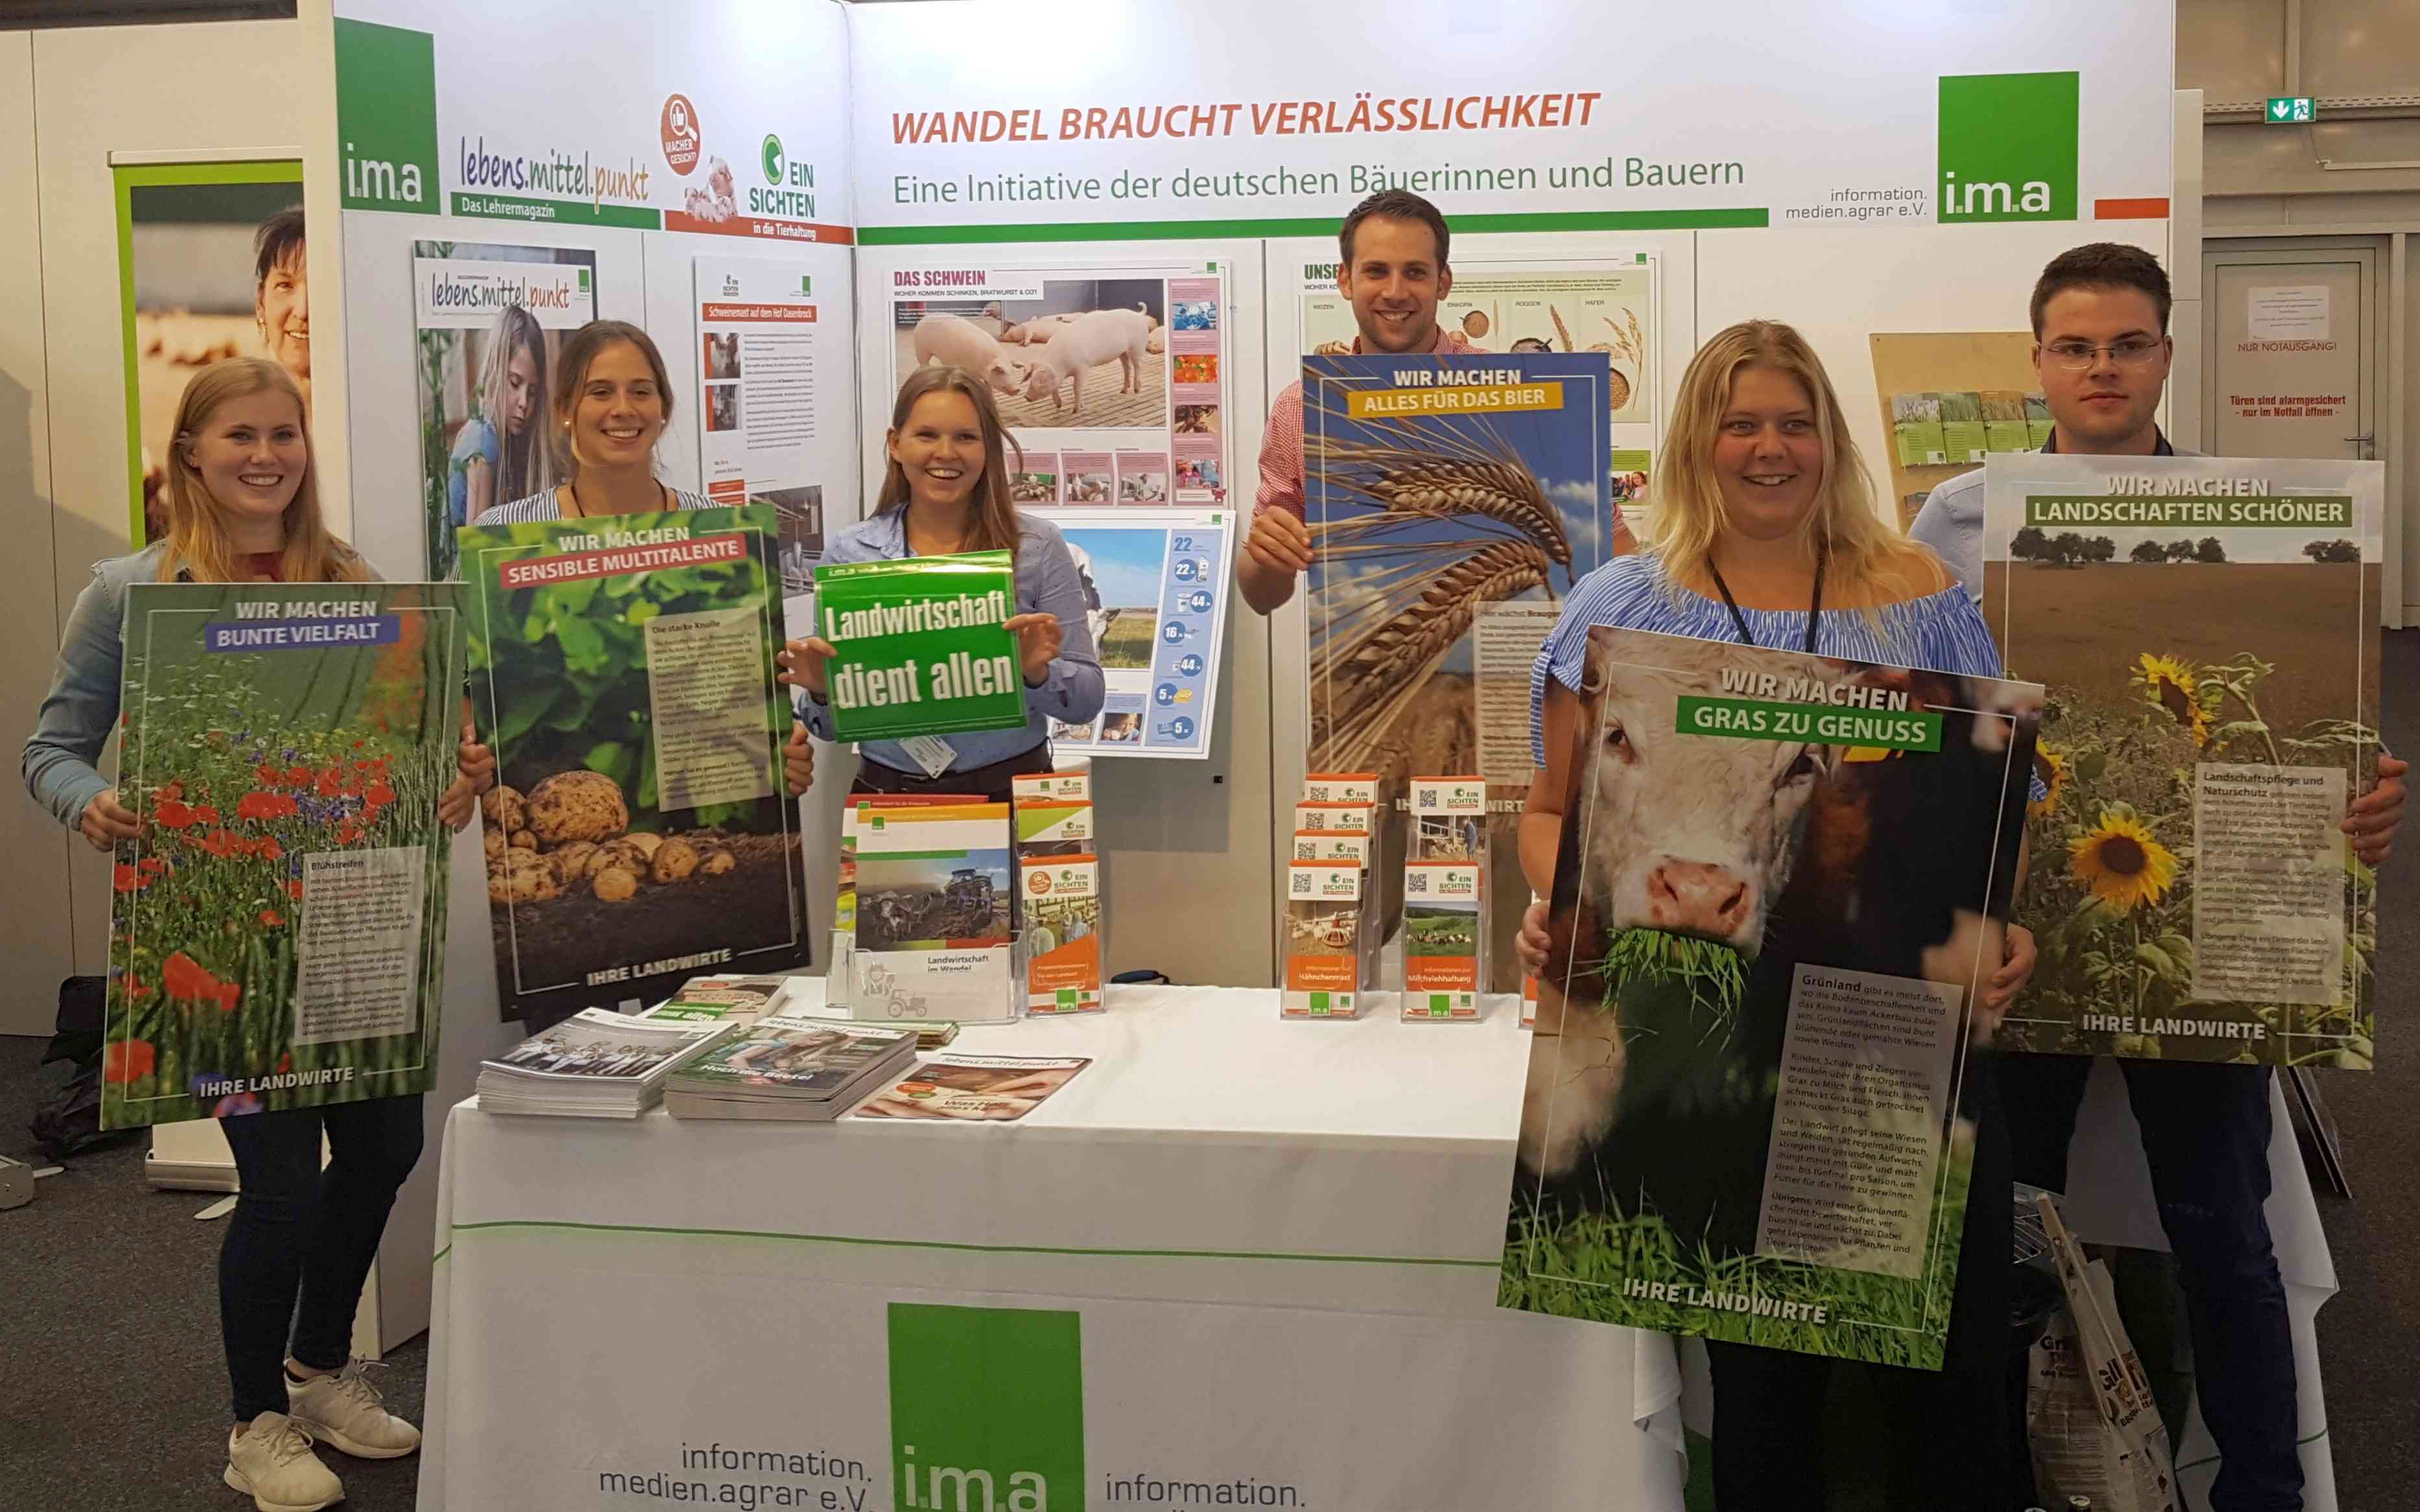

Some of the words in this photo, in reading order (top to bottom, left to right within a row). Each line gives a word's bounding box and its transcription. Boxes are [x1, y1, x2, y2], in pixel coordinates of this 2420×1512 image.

[892, 108, 1048, 144] WANDEL
[1058, 103, 1242, 141] BRAUCHT
[1251, 91, 1601, 135] VERLÄSSLICHKEIT
[666, 139, 694, 153] MACHER
[346, 143, 423, 202] i.m.a
[461, 136, 649, 214] lebens.mittel.punkt
[790, 162, 814, 187] EIN
[893, 175, 958, 204] Eine
[968, 172, 1101, 202] Initiative
[1110, 169, 1162, 199] der
[1171, 165, 1339, 198] deutschen
[1350, 162, 1536, 194] Bäuerinnen
[1548, 156, 1613, 189] und
[1625, 156, 1745, 187] Bauern
[749, 187, 816, 218] SICHTEN
[1830, 187, 1928, 203] information.
[1946, 171, 2051, 215] i.m.a
[462, 197, 482, 213] Das
[483, 199, 555, 219] Lehrermagazin
[1785, 202, 1894, 221] medien.agrar
[1899, 202, 1928, 217] e.V.
[753, 221, 760, 234] in
[763, 222, 775, 235] die
[776, 223, 817, 241] Tierhaltung
[893, 270, 921, 286] DAS
[924, 270, 986, 286] SCHWEIN
[432, 272, 570, 313] lebens.mittel.punkt
[2238, 343, 2258, 352] NUR
[2262, 342, 2337, 352] NOTAUSGANG!
[1394, 370, 1433, 387] WIR
[1438, 370, 1521, 387] MACHEN
[1364, 394, 1418, 412] ALLES
[1423, 390, 1459, 409] FÜR
[1462, 392, 1501, 407] DAS
[1508, 389, 1545, 405] BIER
[2231, 396, 2255, 405] Türen
[2257, 396, 2276, 405] sind
[2279, 395, 2346, 407] alarmgesichert
[2242, 408, 2257, 417] nur
[2260, 407, 2271, 417] im
[2273, 407, 2303, 417] Notfall
[2305, 407, 2333, 417] öffnen
[2107, 475, 2157, 496] WIR
[2163, 477, 2270, 498] MACHEN
[2034, 502, 2223, 522] LANDSCHAFTEN
[2229, 499, 2344, 522] SCHÖNER
[559, 531, 599, 552] WIR
[605, 526, 691, 549] MACHEN
[1174, 537, 1192, 552] 22
[507, 556, 599, 584] SENSIBLE
[602, 539, 738, 571] MULTITALENTE
[235, 602, 279, 620] WIR
[284, 601, 377, 619] MACHEN
[825, 590, 1006, 642] Landwirtschaft
[217, 626, 287, 647] BUNTE
[291, 622, 380, 643] VIELFALT
[695, 620, 720, 629] Knolle
[834, 659, 922, 710] dient
[930, 651, 1015, 701] allen
[1721, 667, 1776, 697] WIR
[1784, 677, 1909, 712] MACHEN
[1694, 706, 1767, 733] GRAS
[1774, 711, 1810, 735] ZU
[1817, 714, 1927, 744] GENUSS
[2203, 786, 2268, 797] Naturschutz
[2204, 772, 2300, 786] Landschaftspflege
[2303, 776, 2324, 786] und
[311, 860, 364, 870] Blühstreifen
[587, 967, 631, 987] IHRE
[633, 948, 732, 979] LANDWIRTE
[928, 955, 989, 964] Landwirtschaft
[1802, 974, 1861, 992] Grünland
[2083, 1014, 2135, 1033] IHRE
[2140, 1016, 2267, 1040] LANDWIRTE
[200, 1079, 245, 1098] IHRE
[248, 1066, 355, 1092] LANDWIRTE
[1623, 1277, 1680, 1303] IHRE
[1687, 1288, 1828, 1324] LANDWIRTE
[681, 1442, 872, 1482] information.
[599, 1471, 808, 1512] medien.agrar
[1106, 1473, 1307, 1507] information.
